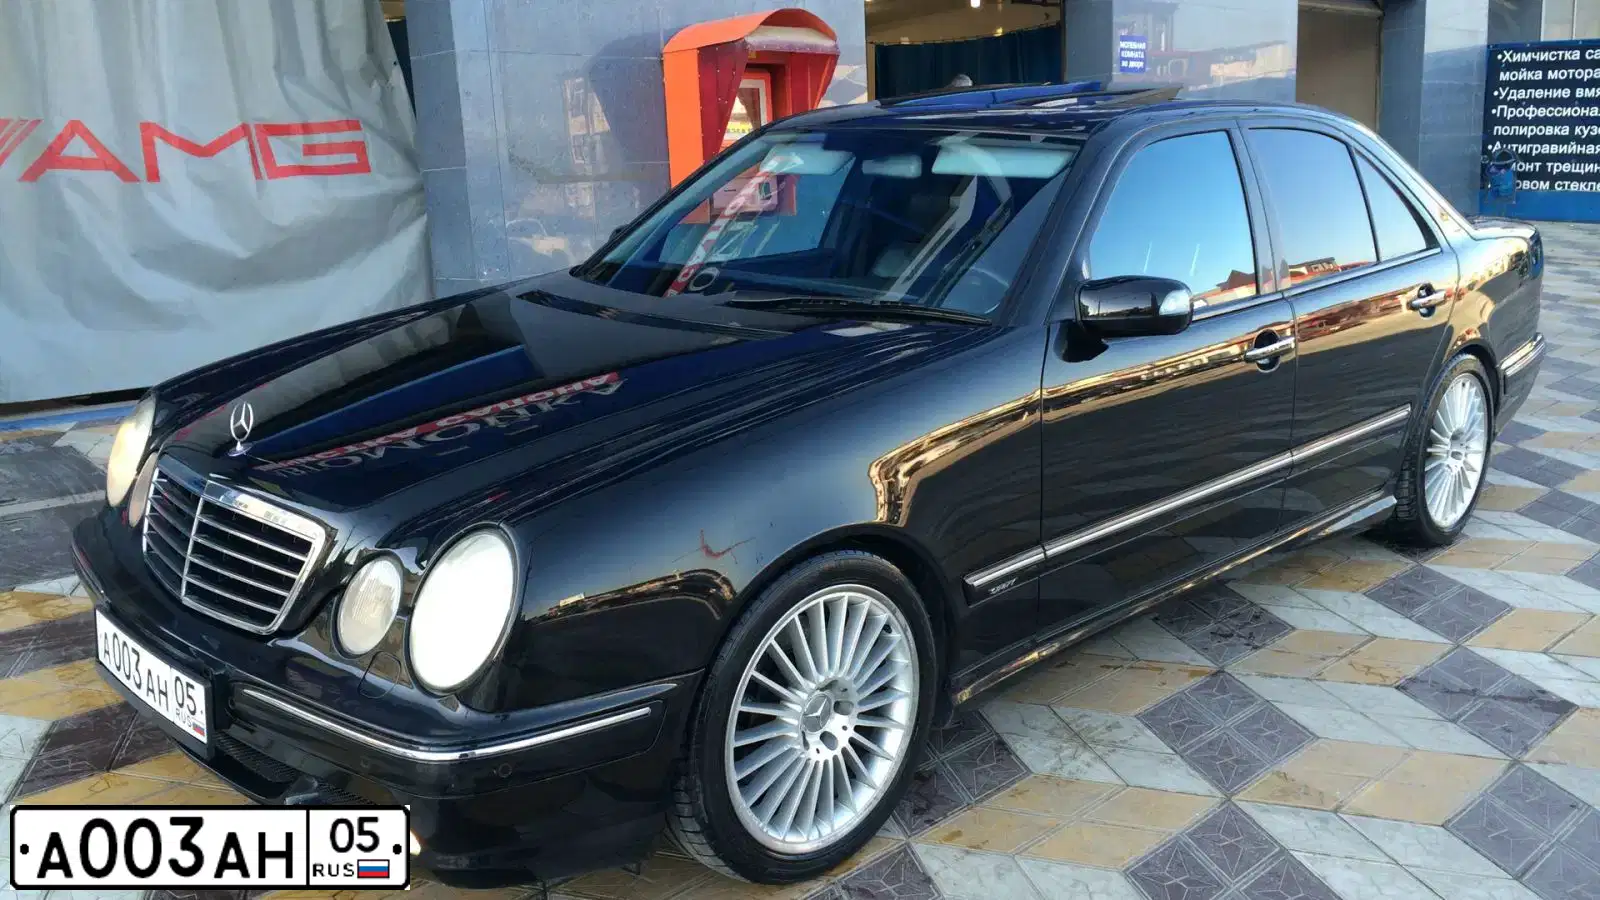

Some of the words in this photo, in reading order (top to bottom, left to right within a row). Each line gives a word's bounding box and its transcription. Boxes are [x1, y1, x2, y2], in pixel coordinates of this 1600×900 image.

[1502, 49, 1580, 63] Химчистка
[1500, 68, 1542, 82] мойка
[1547, 68, 1600, 82] мотора
[1499, 87, 1571, 100] Удаление
[1496, 105, 1600, 120] Профессиона
[1493, 124, 1570, 139] полировка
[1574, 125, 1600, 139] куз
[17, 118, 371, 183] AMG
[174, 675, 197, 716] 05
[175, 707, 193, 728] RUS
